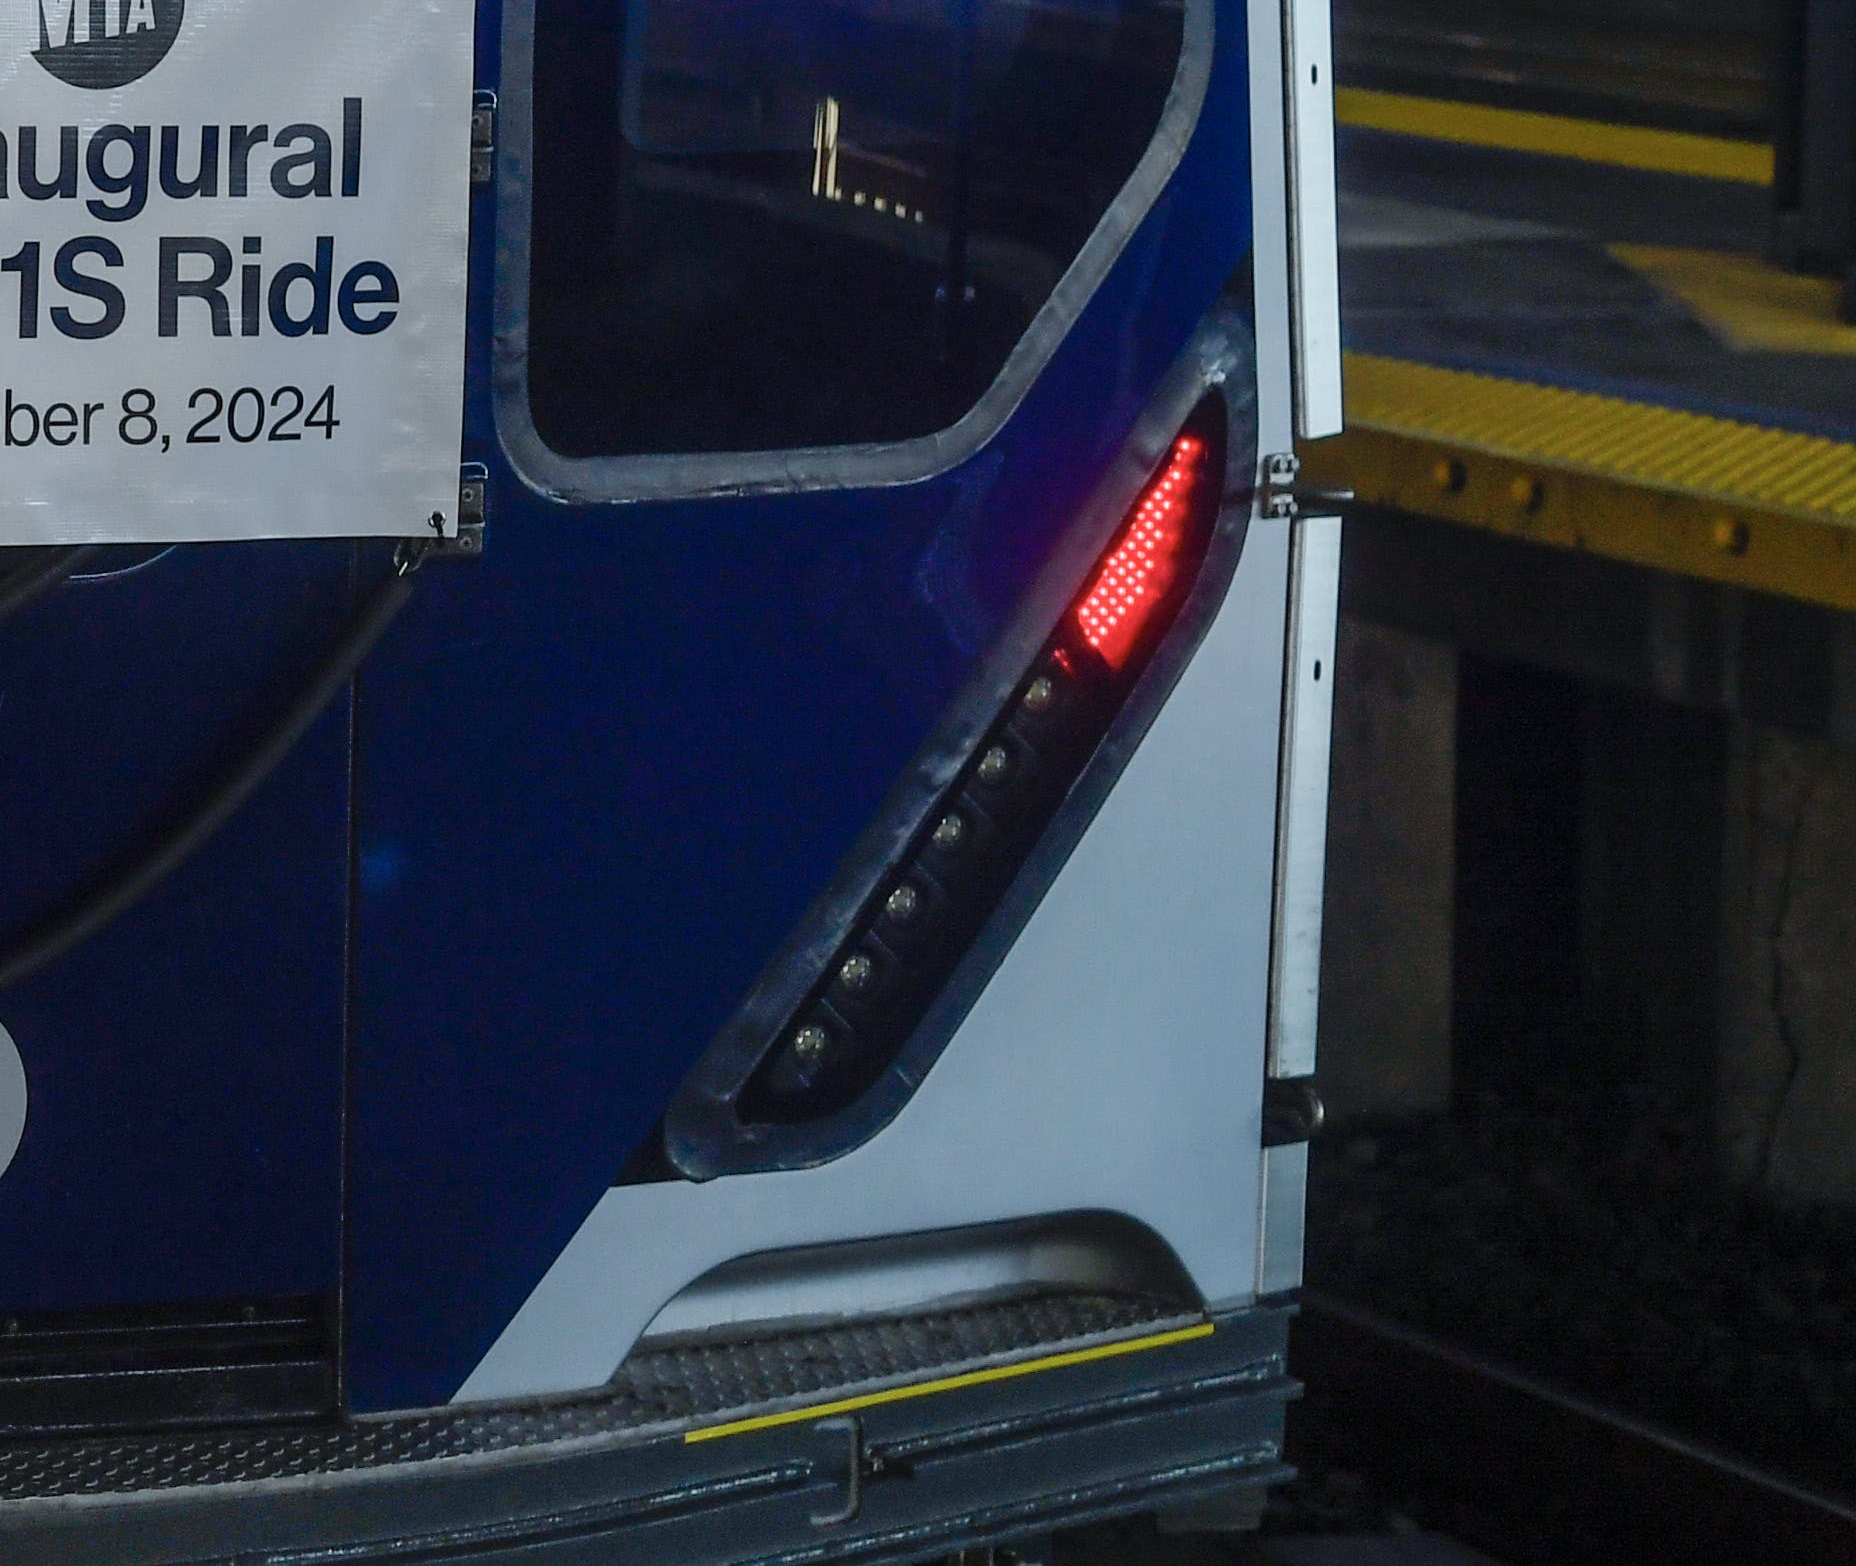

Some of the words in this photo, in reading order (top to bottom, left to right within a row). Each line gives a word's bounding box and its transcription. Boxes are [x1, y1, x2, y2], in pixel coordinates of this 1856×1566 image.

[158, 234, 401, 338] Ride
[116, 387, 171, 456] 8,
[186, 384, 341, 444] 2024
